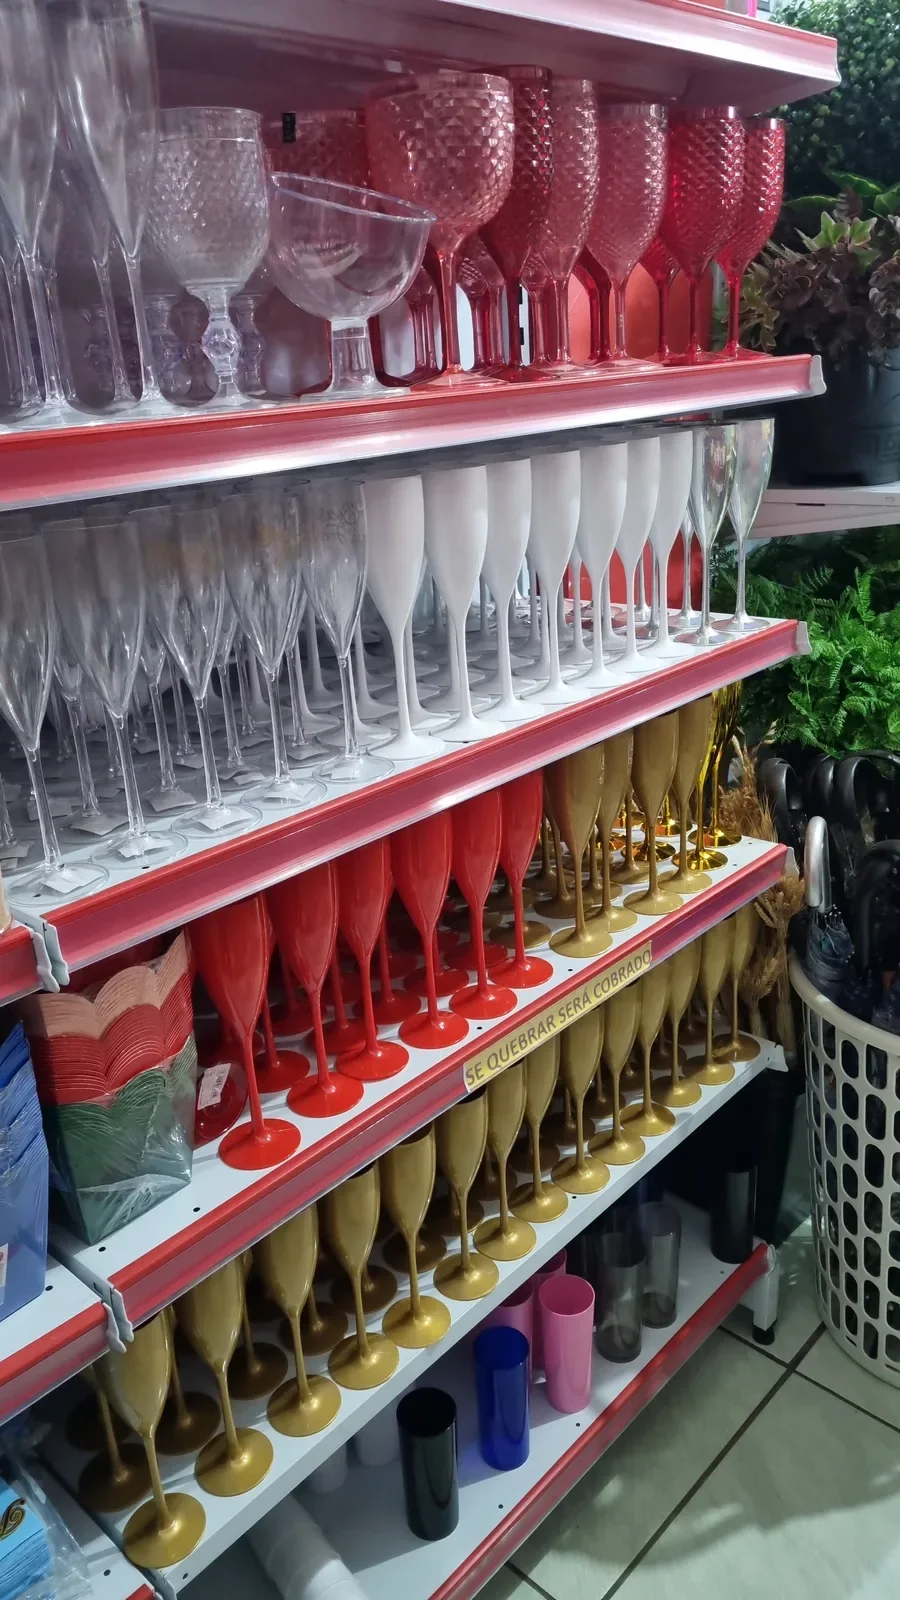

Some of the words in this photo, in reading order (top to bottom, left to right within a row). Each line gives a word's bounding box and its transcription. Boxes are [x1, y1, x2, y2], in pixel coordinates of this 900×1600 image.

[465, 1065, 485, 1086] SE
[486, 1014, 556, 1070] QUEBRAR
[558, 988, 592, 1024] SERÁ
[593, 949, 652, 999] COBRADO
